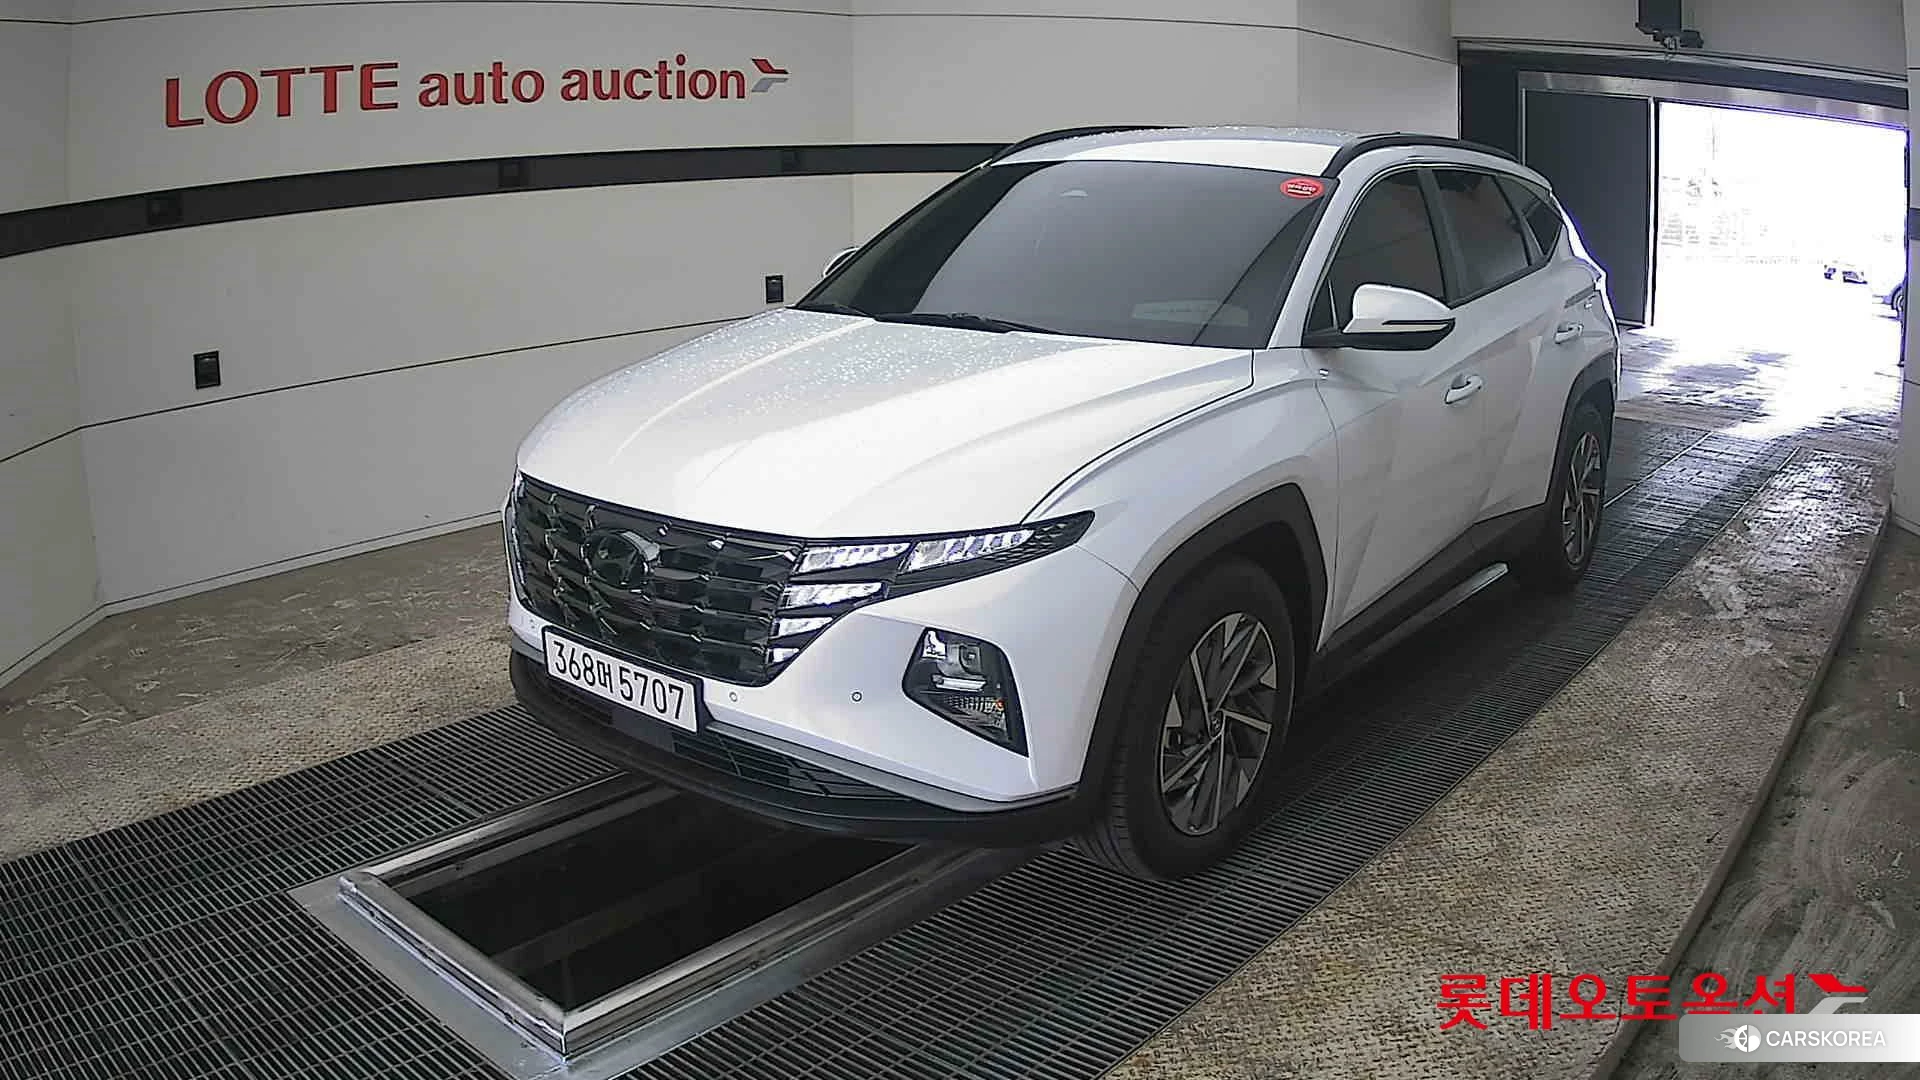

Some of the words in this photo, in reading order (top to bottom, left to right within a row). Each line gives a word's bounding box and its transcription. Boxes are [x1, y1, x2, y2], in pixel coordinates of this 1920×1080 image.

[165, 60, 399, 128] LOTTE
[418, 61, 545, 107] auto
[560, 53, 746, 102] auction
[618, 665, 684, 720] 5707
